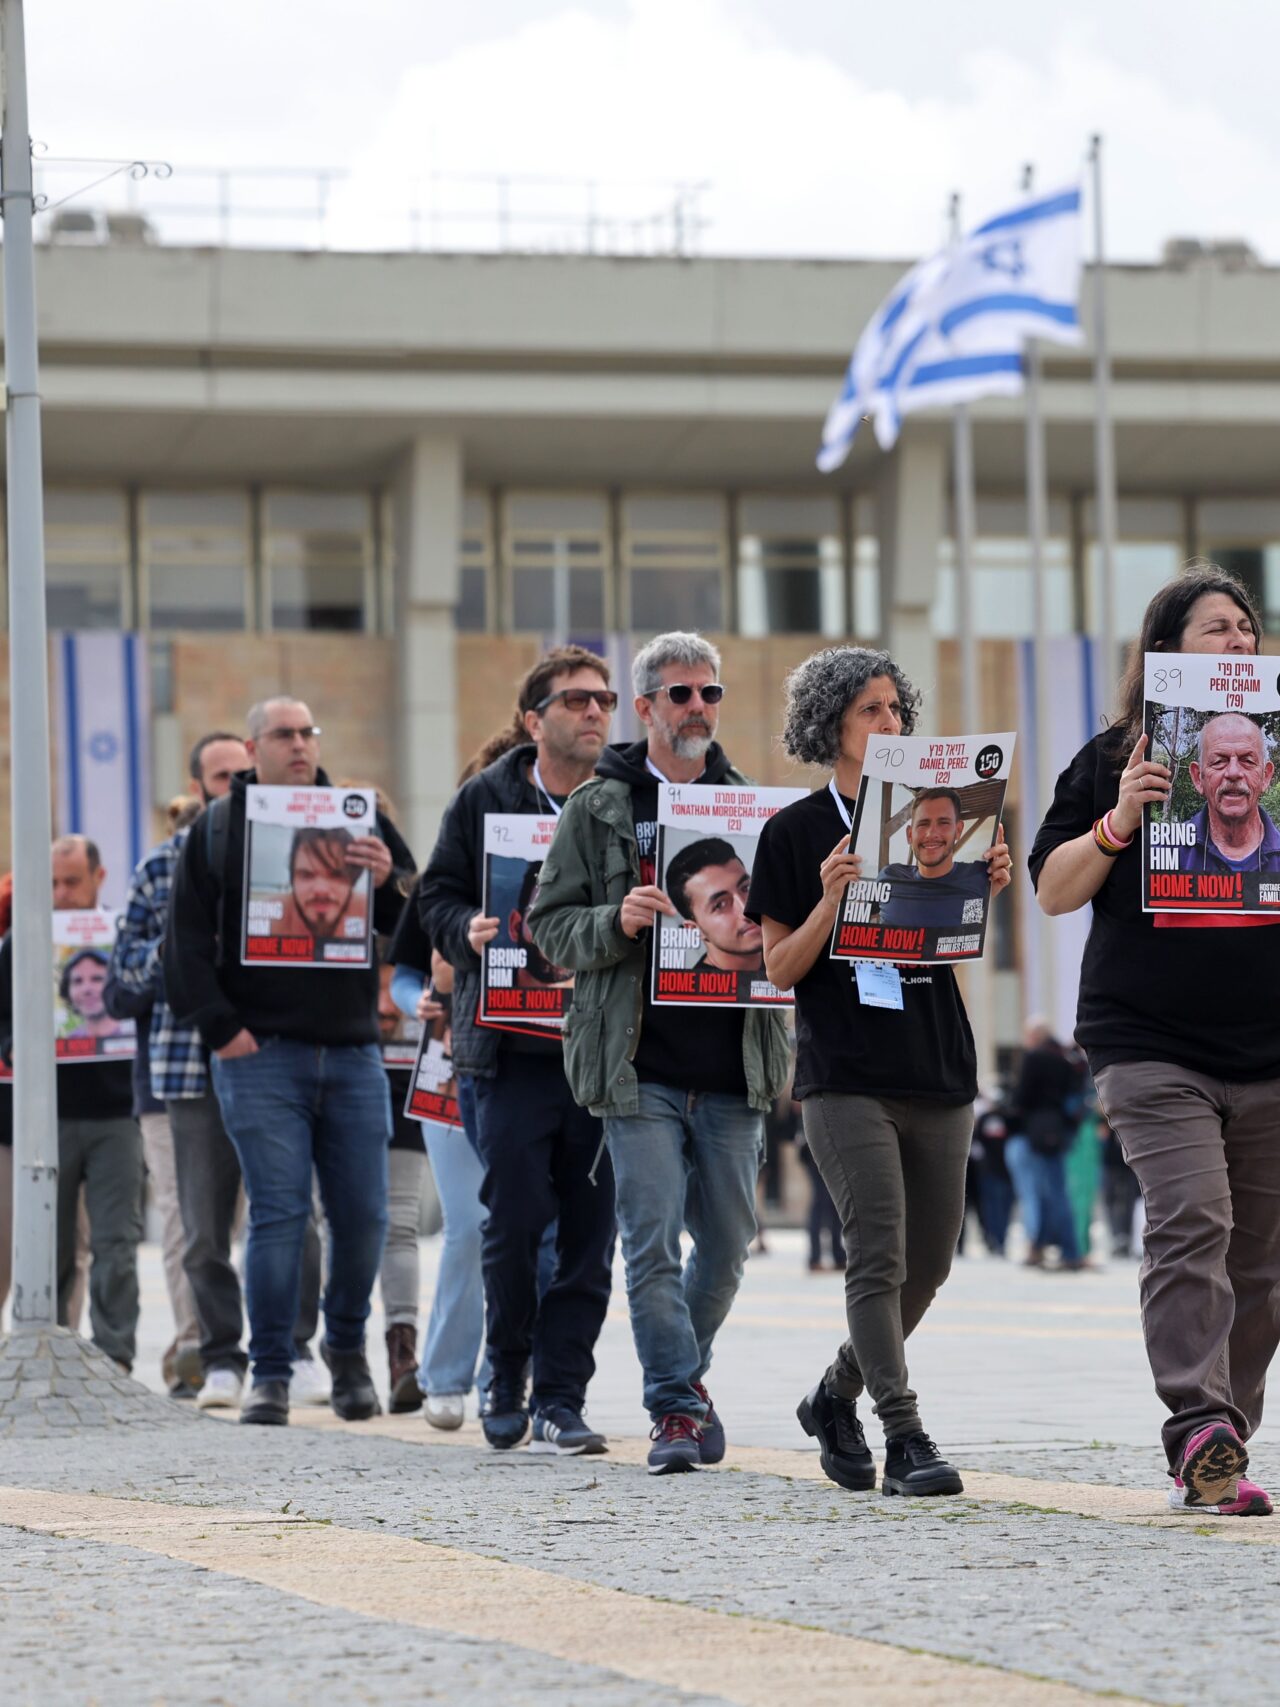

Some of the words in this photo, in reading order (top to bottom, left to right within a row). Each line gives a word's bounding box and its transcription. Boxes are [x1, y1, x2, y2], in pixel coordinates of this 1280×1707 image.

[1218, 663, 1232, 676] פרי
[1235, 663, 1254, 677] חיים
[1153, 668, 1182, 692] 89
[1210, 677, 1229, 692] PERI
[1232, 678, 1260, 692] CHAIM
[1226, 693, 1244, 709] (79)
[875, 748, 905, 767] 90
[929, 744, 943, 757] פרץ
[945, 743, 966, 757] דניאל
[919, 757, 945, 770] DANIEL
[946, 757, 969, 769] PEREZ
[979, 752, 1000, 773] 150
[935, 771, 951, 785] (22)
[671, 804, 710, 816] YONATHAN
[712, 805, 756, 818] MORDECHAI
[493, 825, 513, 842] 92
[728, 820, 742, 832] (21)
[1150, 822, 1196, 846] BRING
[1150, 847, 1179, 870] HIM
[847, 880, 891, 903] BRING
[1150, 873, 1194, 897] HOME
[1197, 872, 1243, 898] NOW!
[843, 901, 872, 923] HIM
[247, 936, 278, 954] HOME
[660, 928, 700, 949] BRING
[840, 925, 881, 946] HOME
[882, 928, 925, 951] NOW!
[936, 940, 961, 954] FAMILIES
[961, 939, 979, 953] FORUM
[488, 948, 527, 968] BRING
[660, 949, 686, 969] HIM
[488, 968, 513, 987] HIM
[659, 972, 696, 992] HOME
[699, 972, 737, 993] NOW!
[488, 989, 523, 1009] HOME
[526, 989, 562, 1009] NOW!
